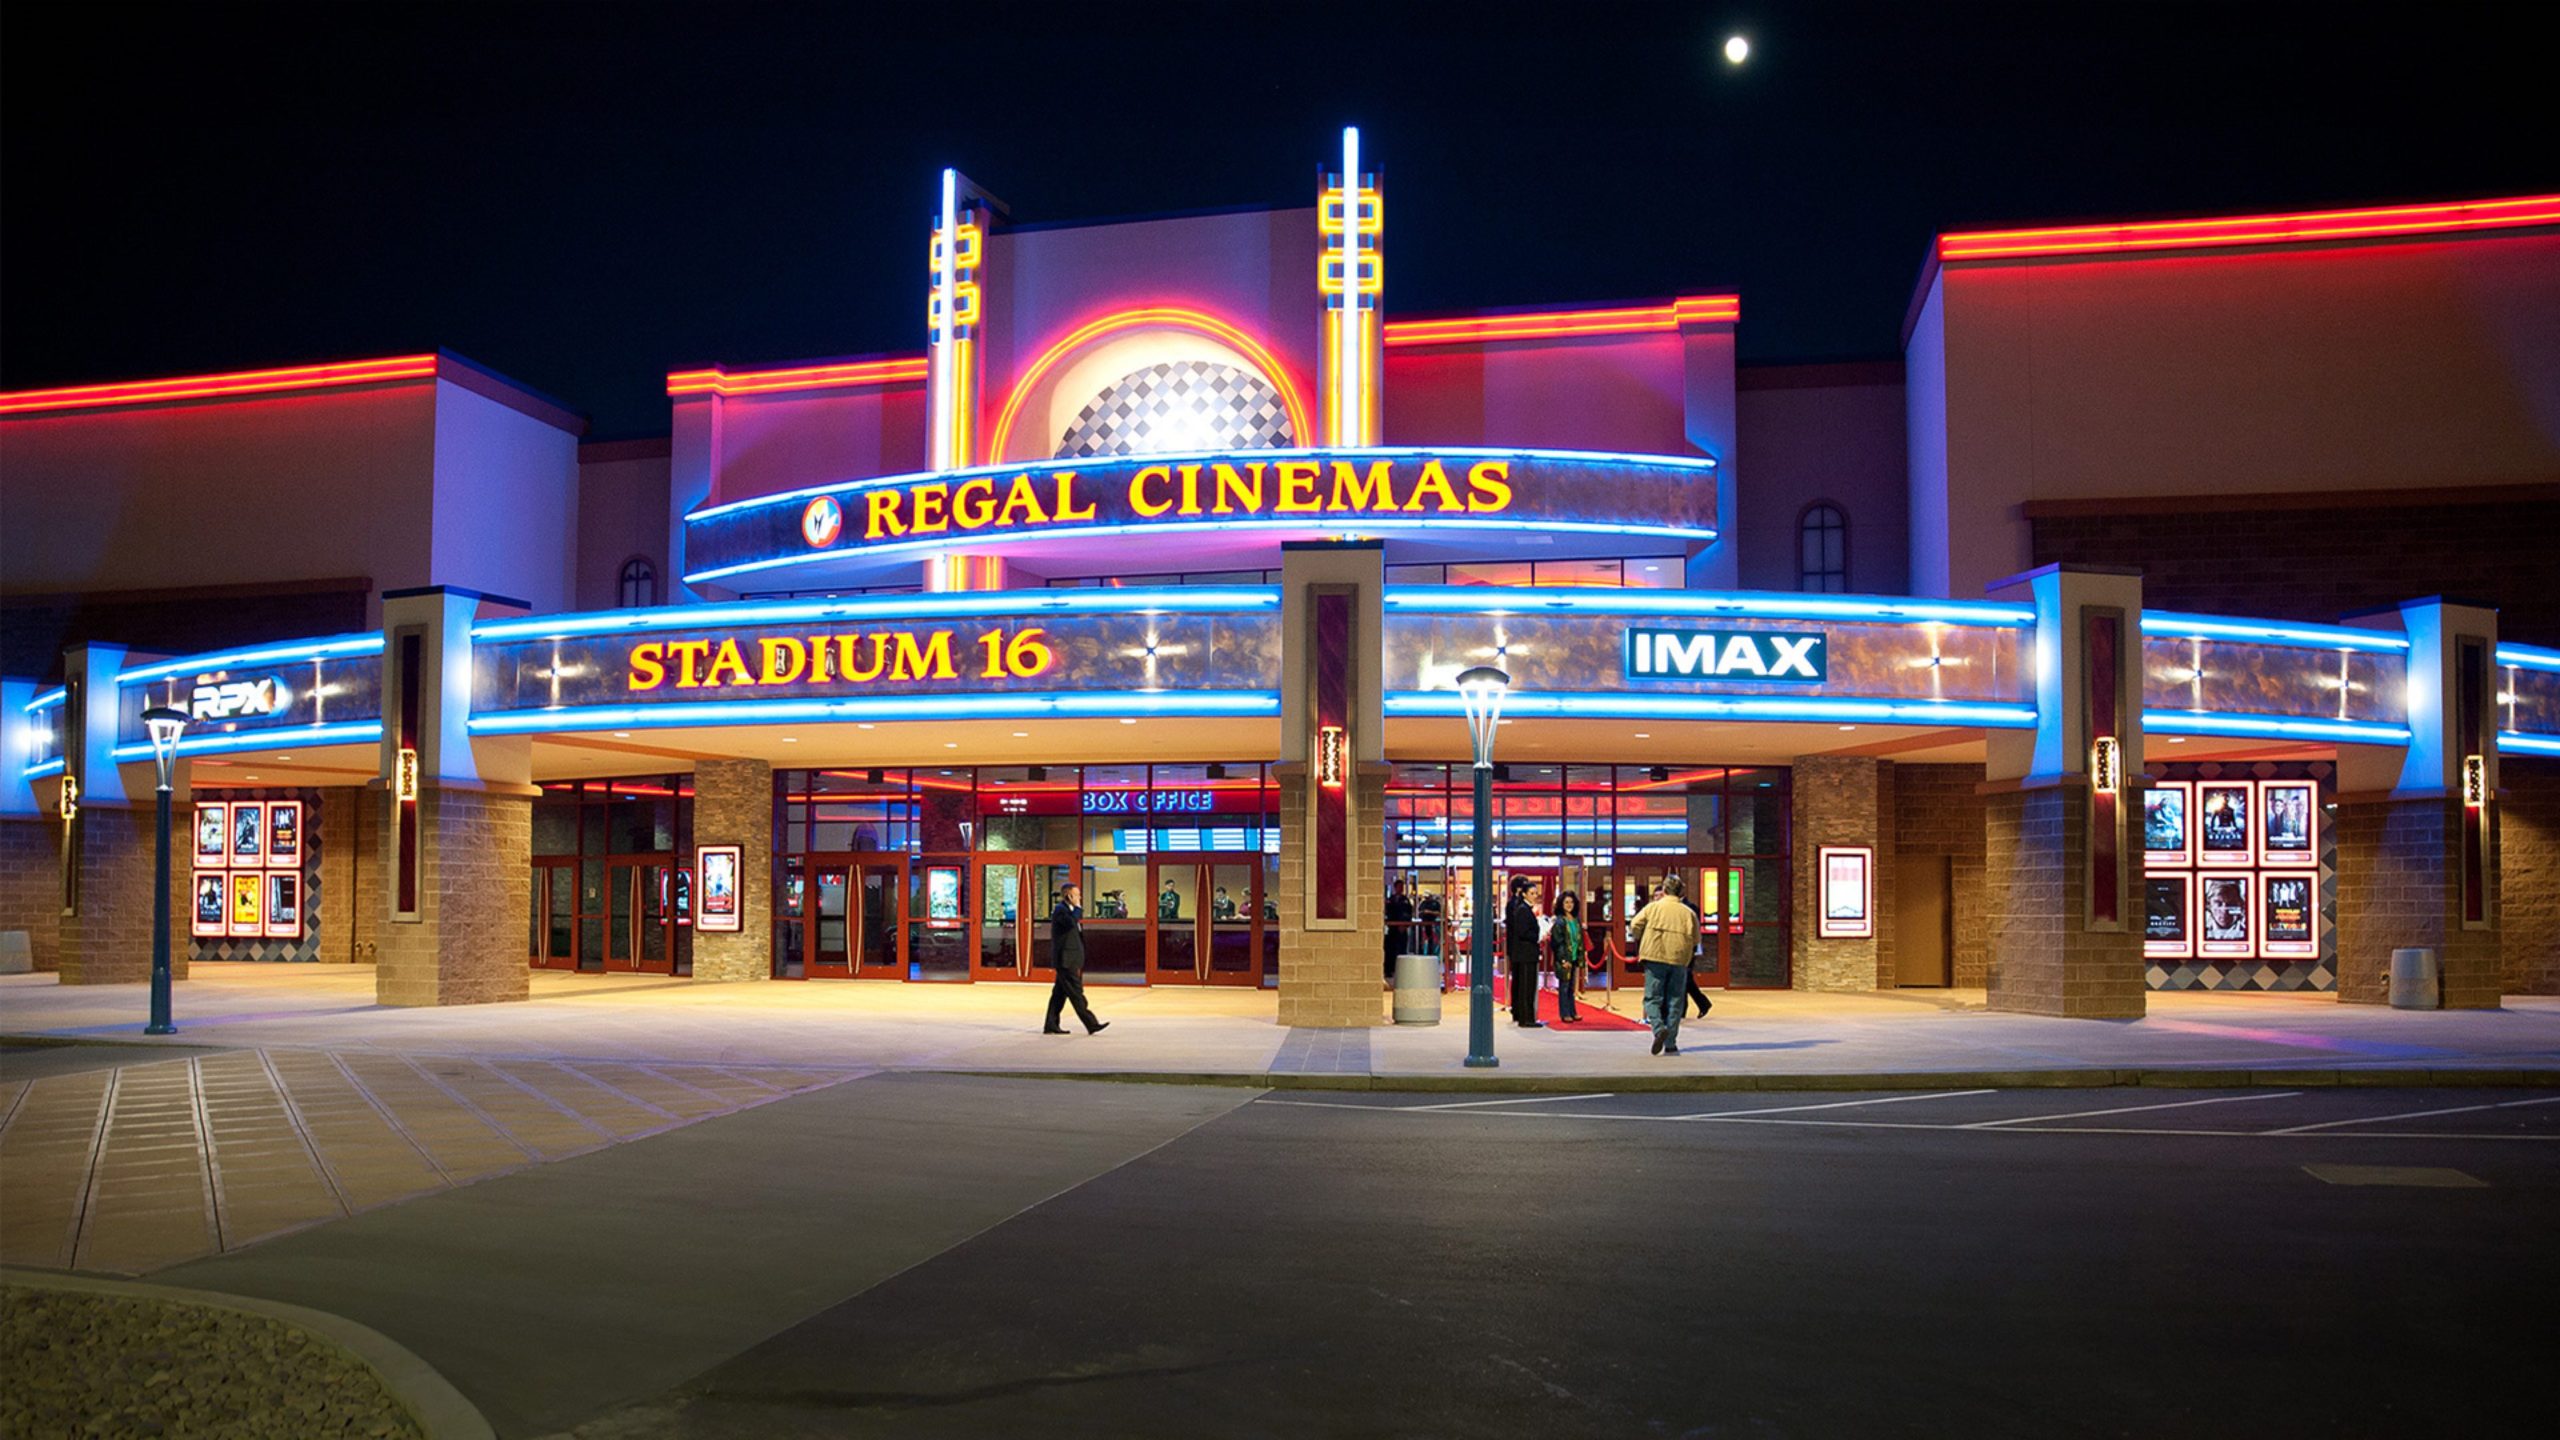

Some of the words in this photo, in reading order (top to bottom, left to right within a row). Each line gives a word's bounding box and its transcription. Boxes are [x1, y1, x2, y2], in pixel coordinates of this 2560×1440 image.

[864, 471, 1097, 539] REGAL
[1128, 459, 1513, 517] CINEMAS
[628, 632, 958, 691] STADIUM
[978, 628, 1053, 679] 16
[1635, 632, 1819, 677] IMAX
[192, 678, 273, 720] RPX
[1082, 791, 1129, 812] BOX
[1135, 790, 1213, 812] OFFICE
